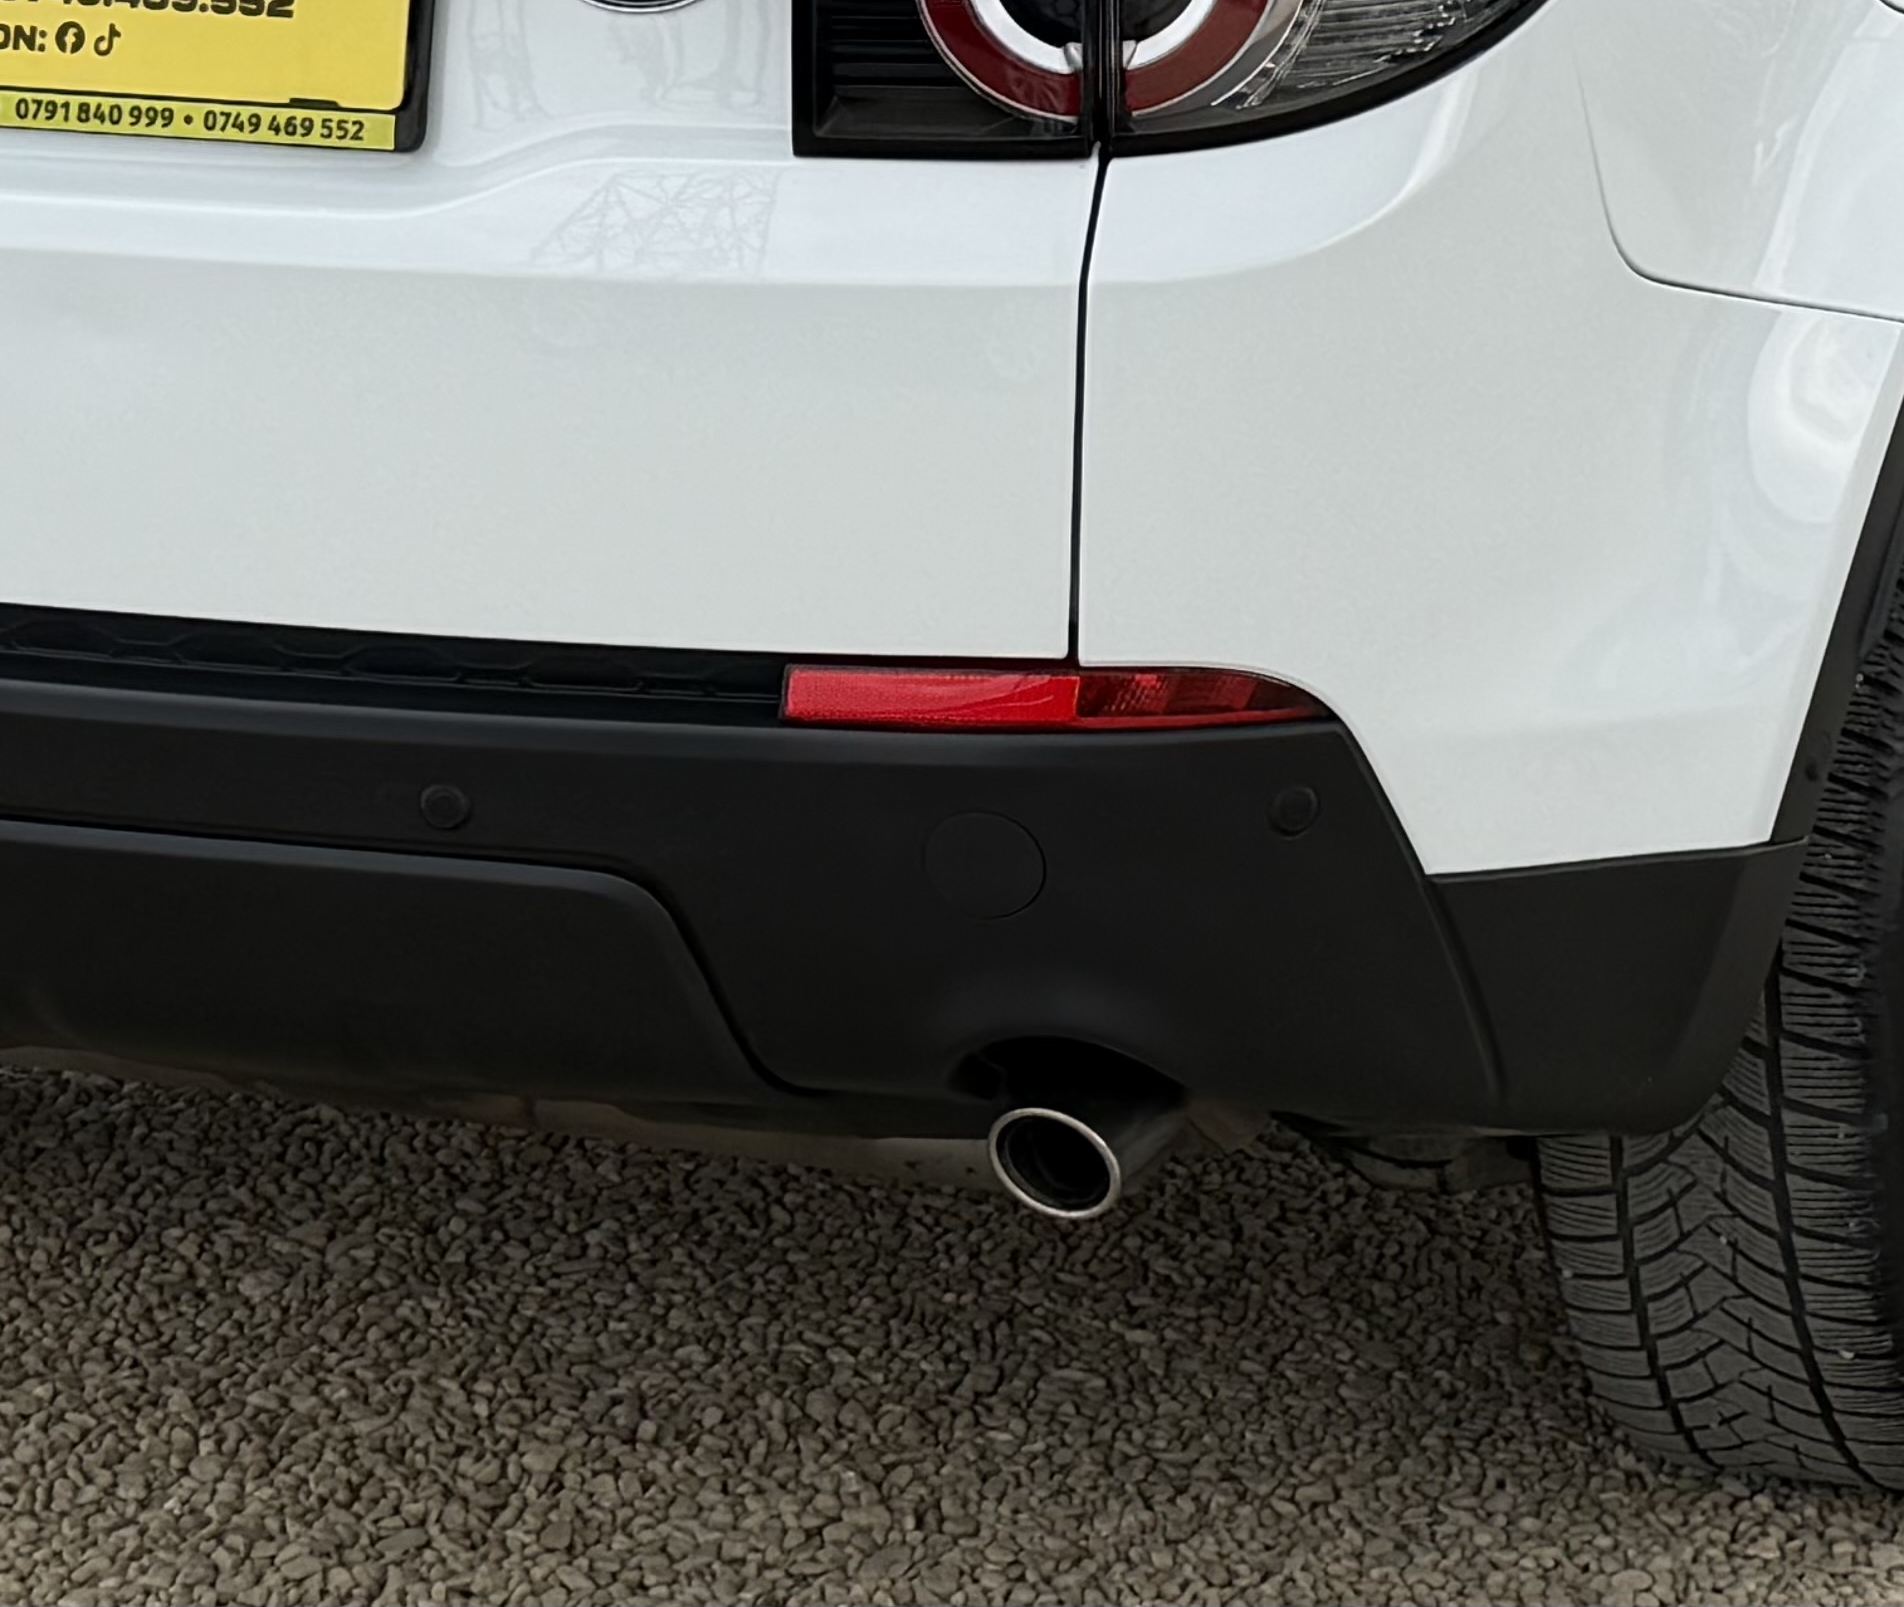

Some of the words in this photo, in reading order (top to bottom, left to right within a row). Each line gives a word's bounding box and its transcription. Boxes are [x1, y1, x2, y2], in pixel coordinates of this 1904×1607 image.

[15, 97, 70, 123] 0791
[76, 102, 123, 128] 840
[128, 105, 174, 130] 999
[203, 110, 262, 135] 0749
[267, 116, 314, 138] 469
[319, 119, 365, 142] 552
